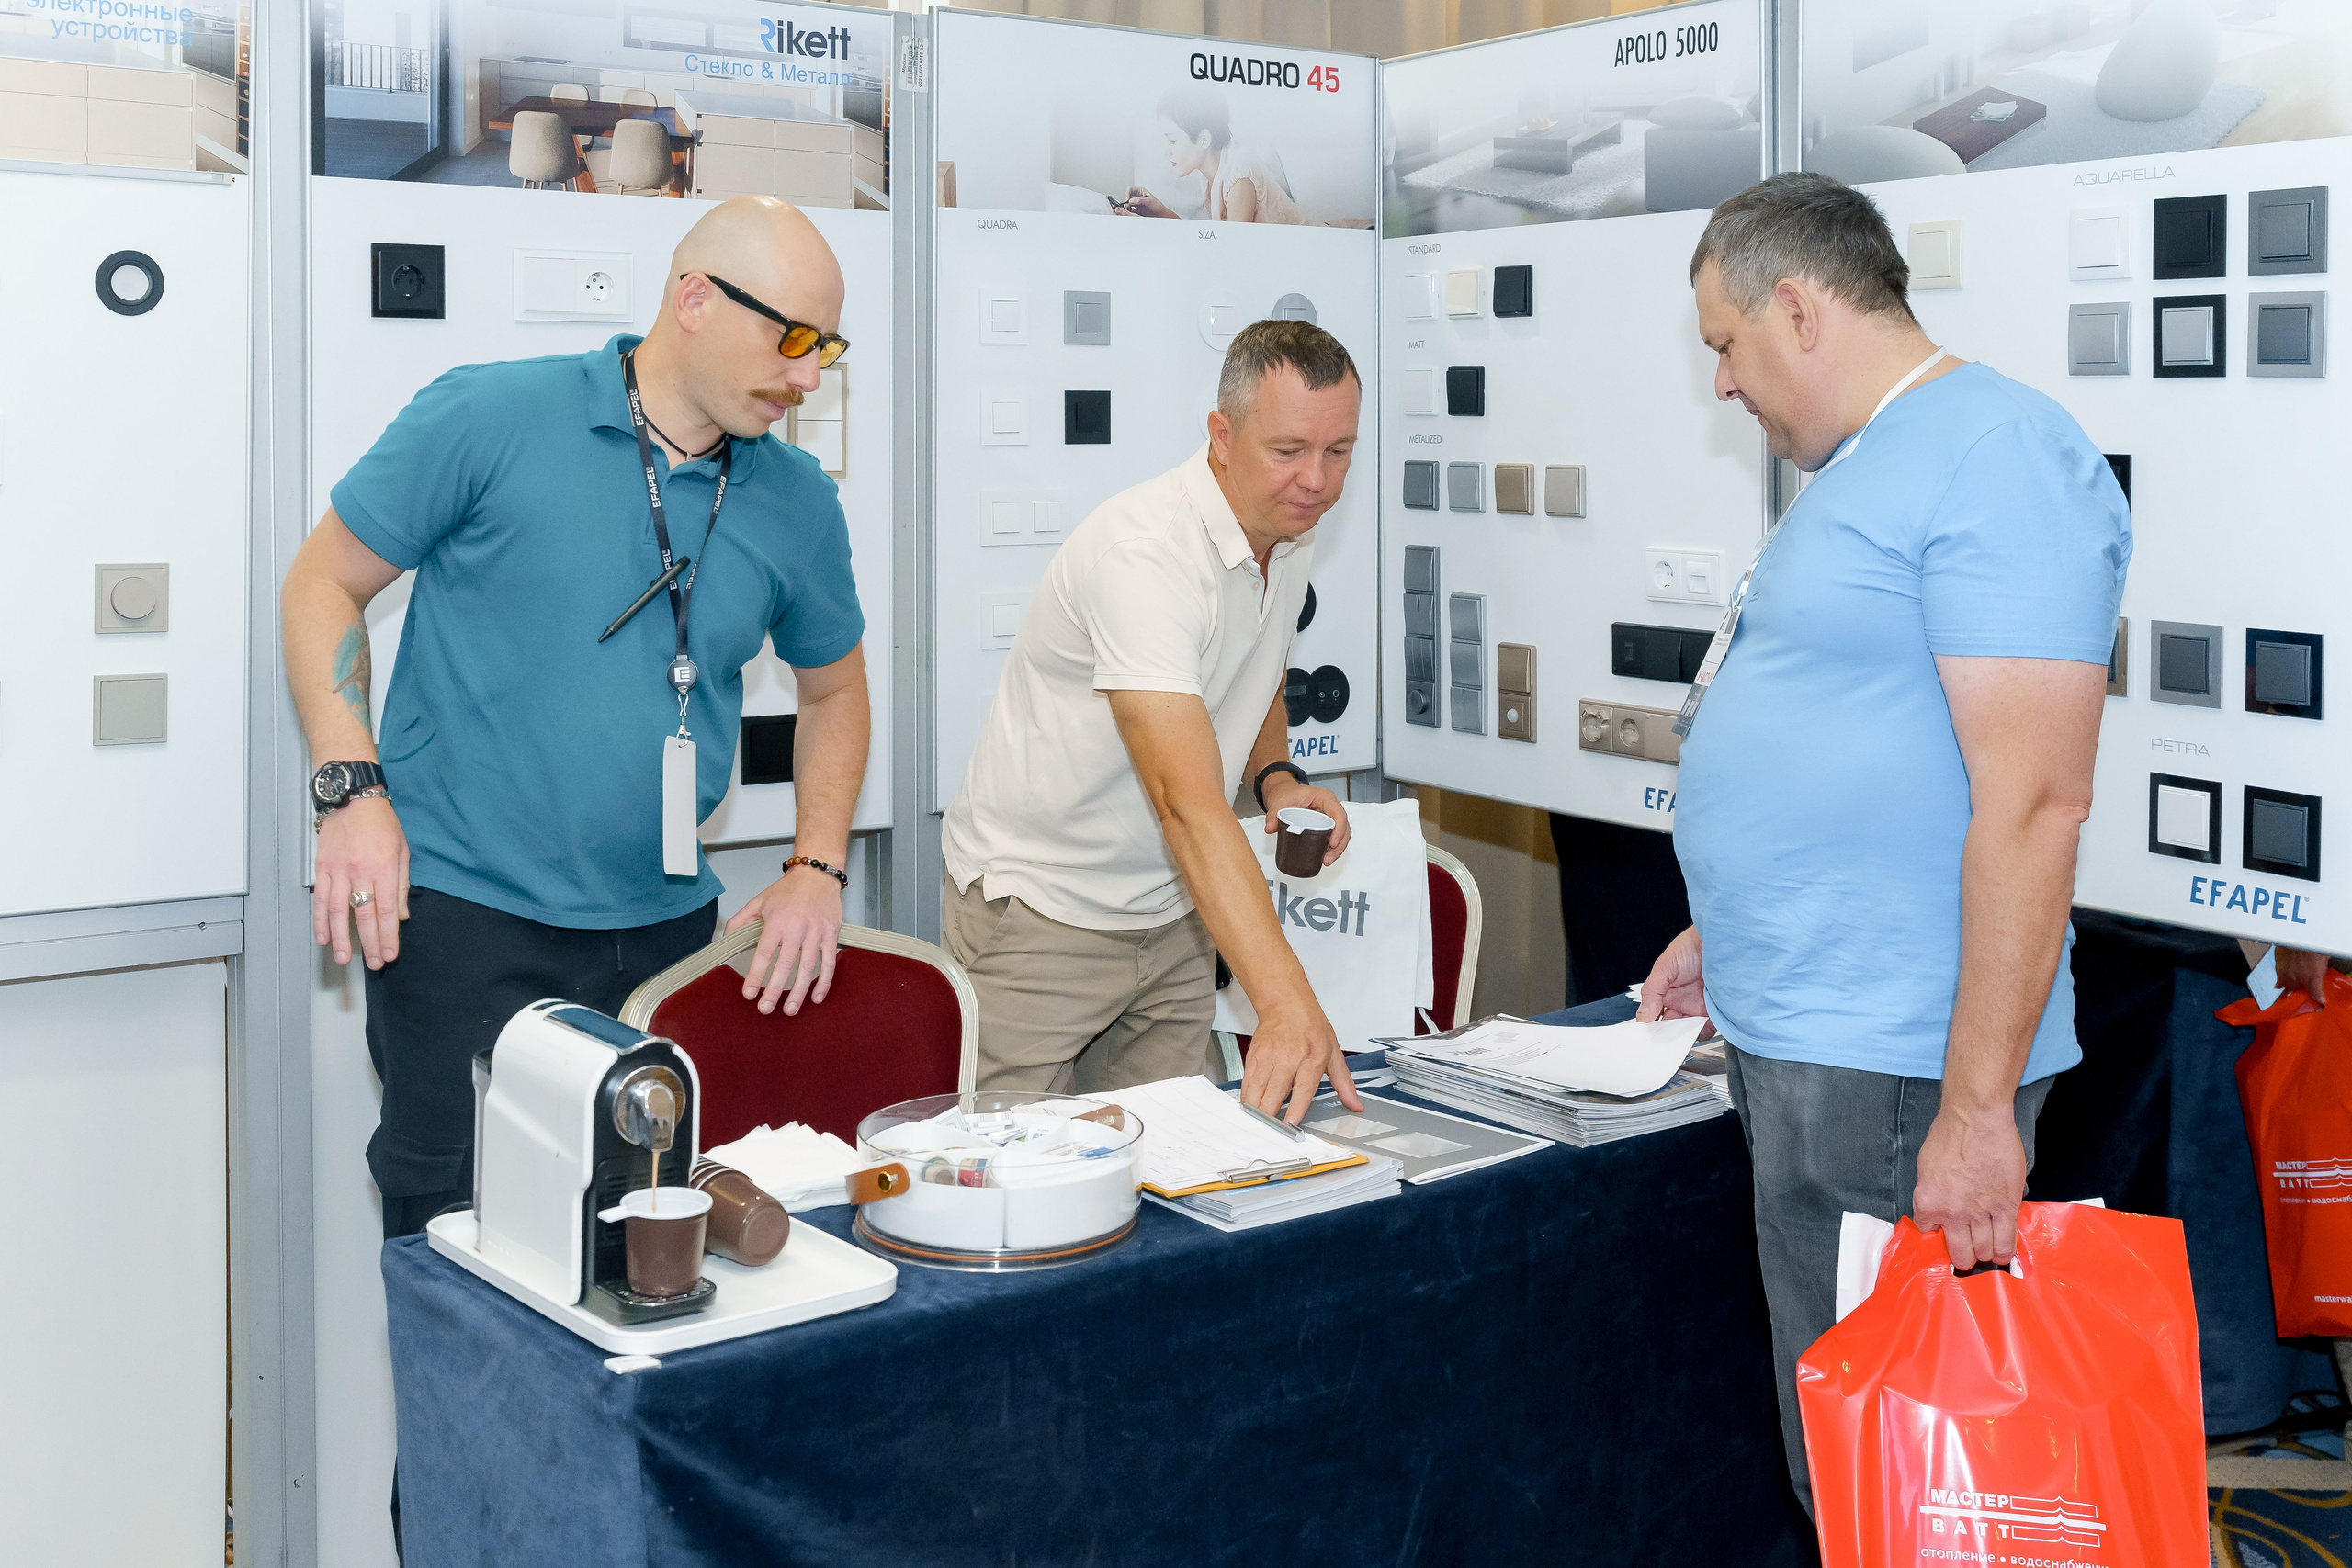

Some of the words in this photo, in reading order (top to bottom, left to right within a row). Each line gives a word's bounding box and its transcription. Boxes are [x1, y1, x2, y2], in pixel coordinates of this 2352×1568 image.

[51, 18, 193, 46] устройства
[760, 17, 852, 61] Rikett
[1614, 31, 1667, 68] APOLO
[1675, 21, 1719, 57] 5000
[684, 53, 754, 77] Стекло
[761, 62, 774, 79] &
[781, 63, 851, 86] Металл
[1189, 52, 1301, 89] QUADRO
[1306, 65, 1340, 93] 45
[2072, 165, 2176, 187] AQUARELLA
[978, 219, 1019, 231] QUADRA
[1198, 229, 1216, 240] SIZA
[1408, 243, 1442, 255] STANDARD
[1408, 340, 1425, 349] MATT
[1408, 434, 1442, 445] METALIZED
[662, 548, 678, 591] EPEL
[1288, 735, 1340, 759] APEL
[2151, 738, 2211, 758] PETRA
[1931, 1488, 2009, 1508] МАСТЕР
[1920, 1548, 1996, 1563] отопление
